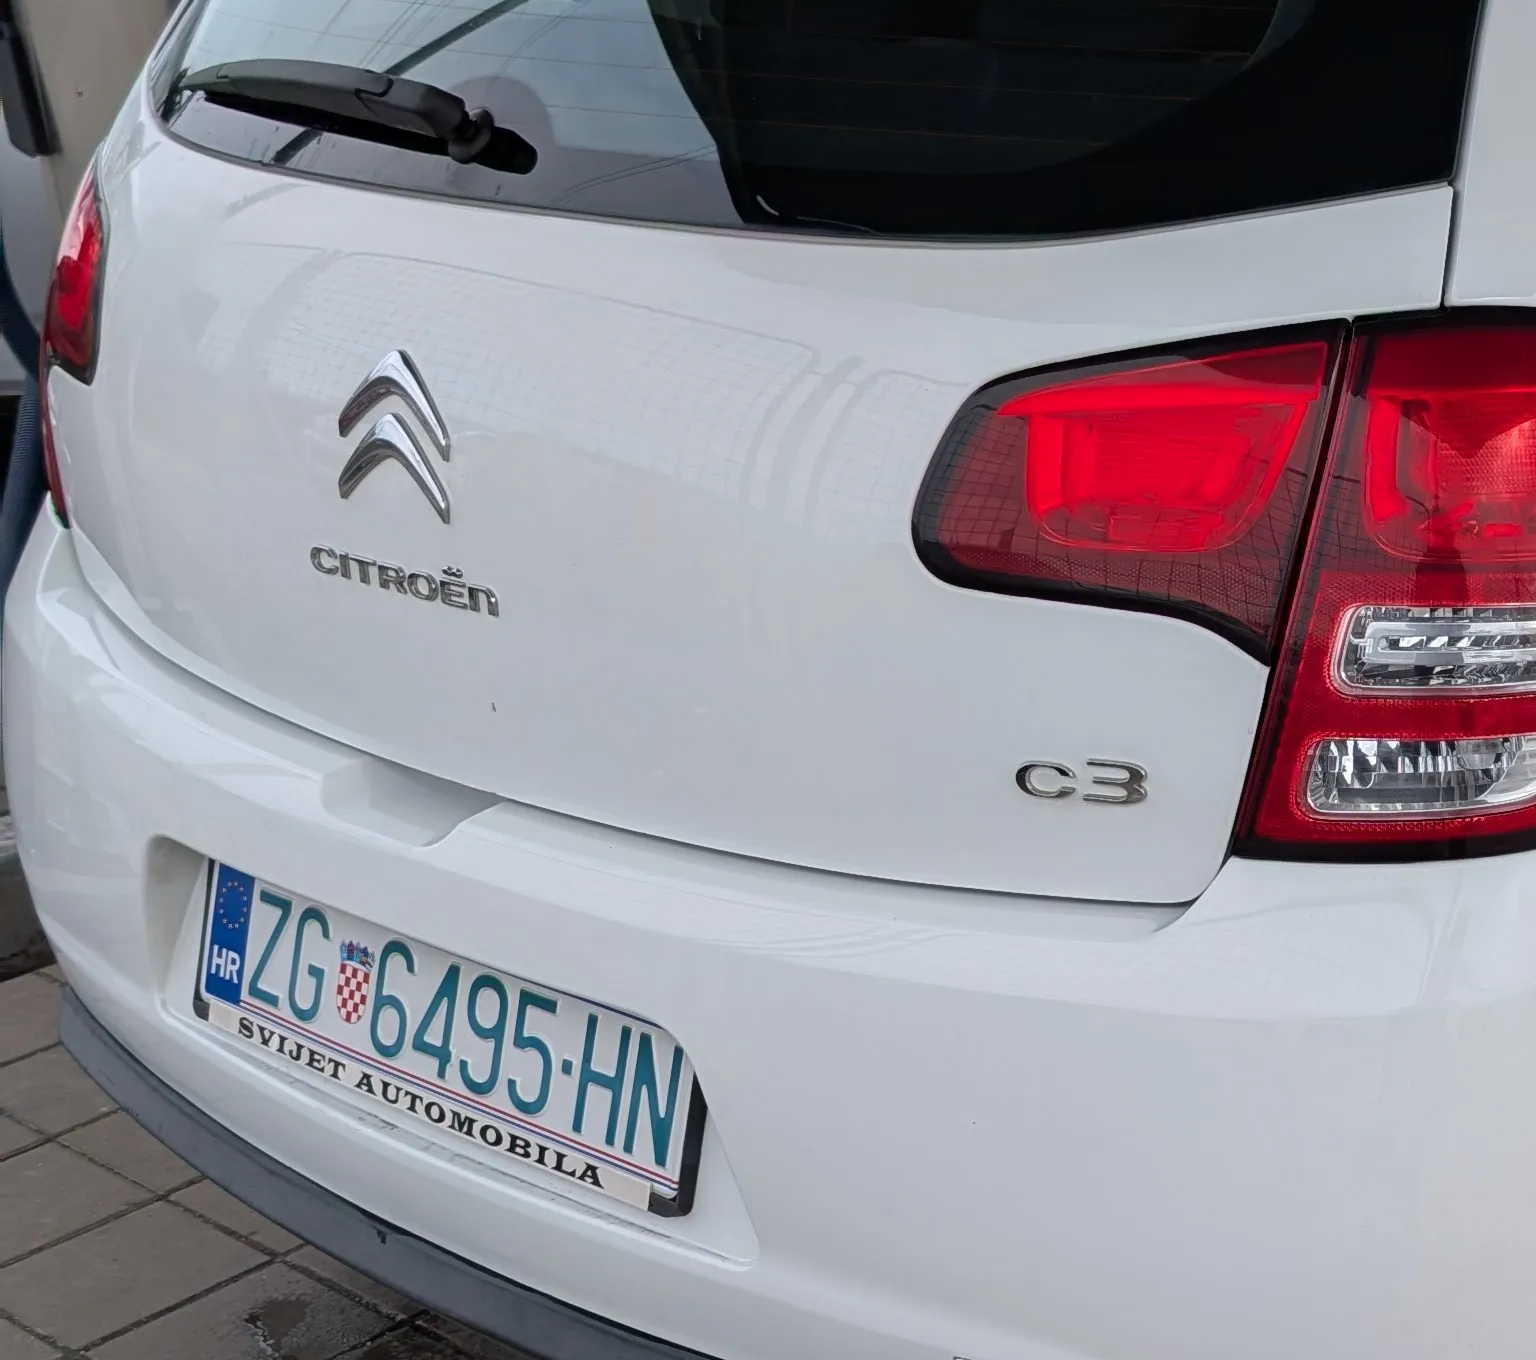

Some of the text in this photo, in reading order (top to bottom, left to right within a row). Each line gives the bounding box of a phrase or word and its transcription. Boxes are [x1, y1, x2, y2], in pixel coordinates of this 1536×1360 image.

[1015, 757, 1149, 805] C3
[209, 944, 241, 986] HR
[248, 889, 332, 1023] ZG
[238, 1016, 605, 1190] SVIJET AUTOMOBILA
